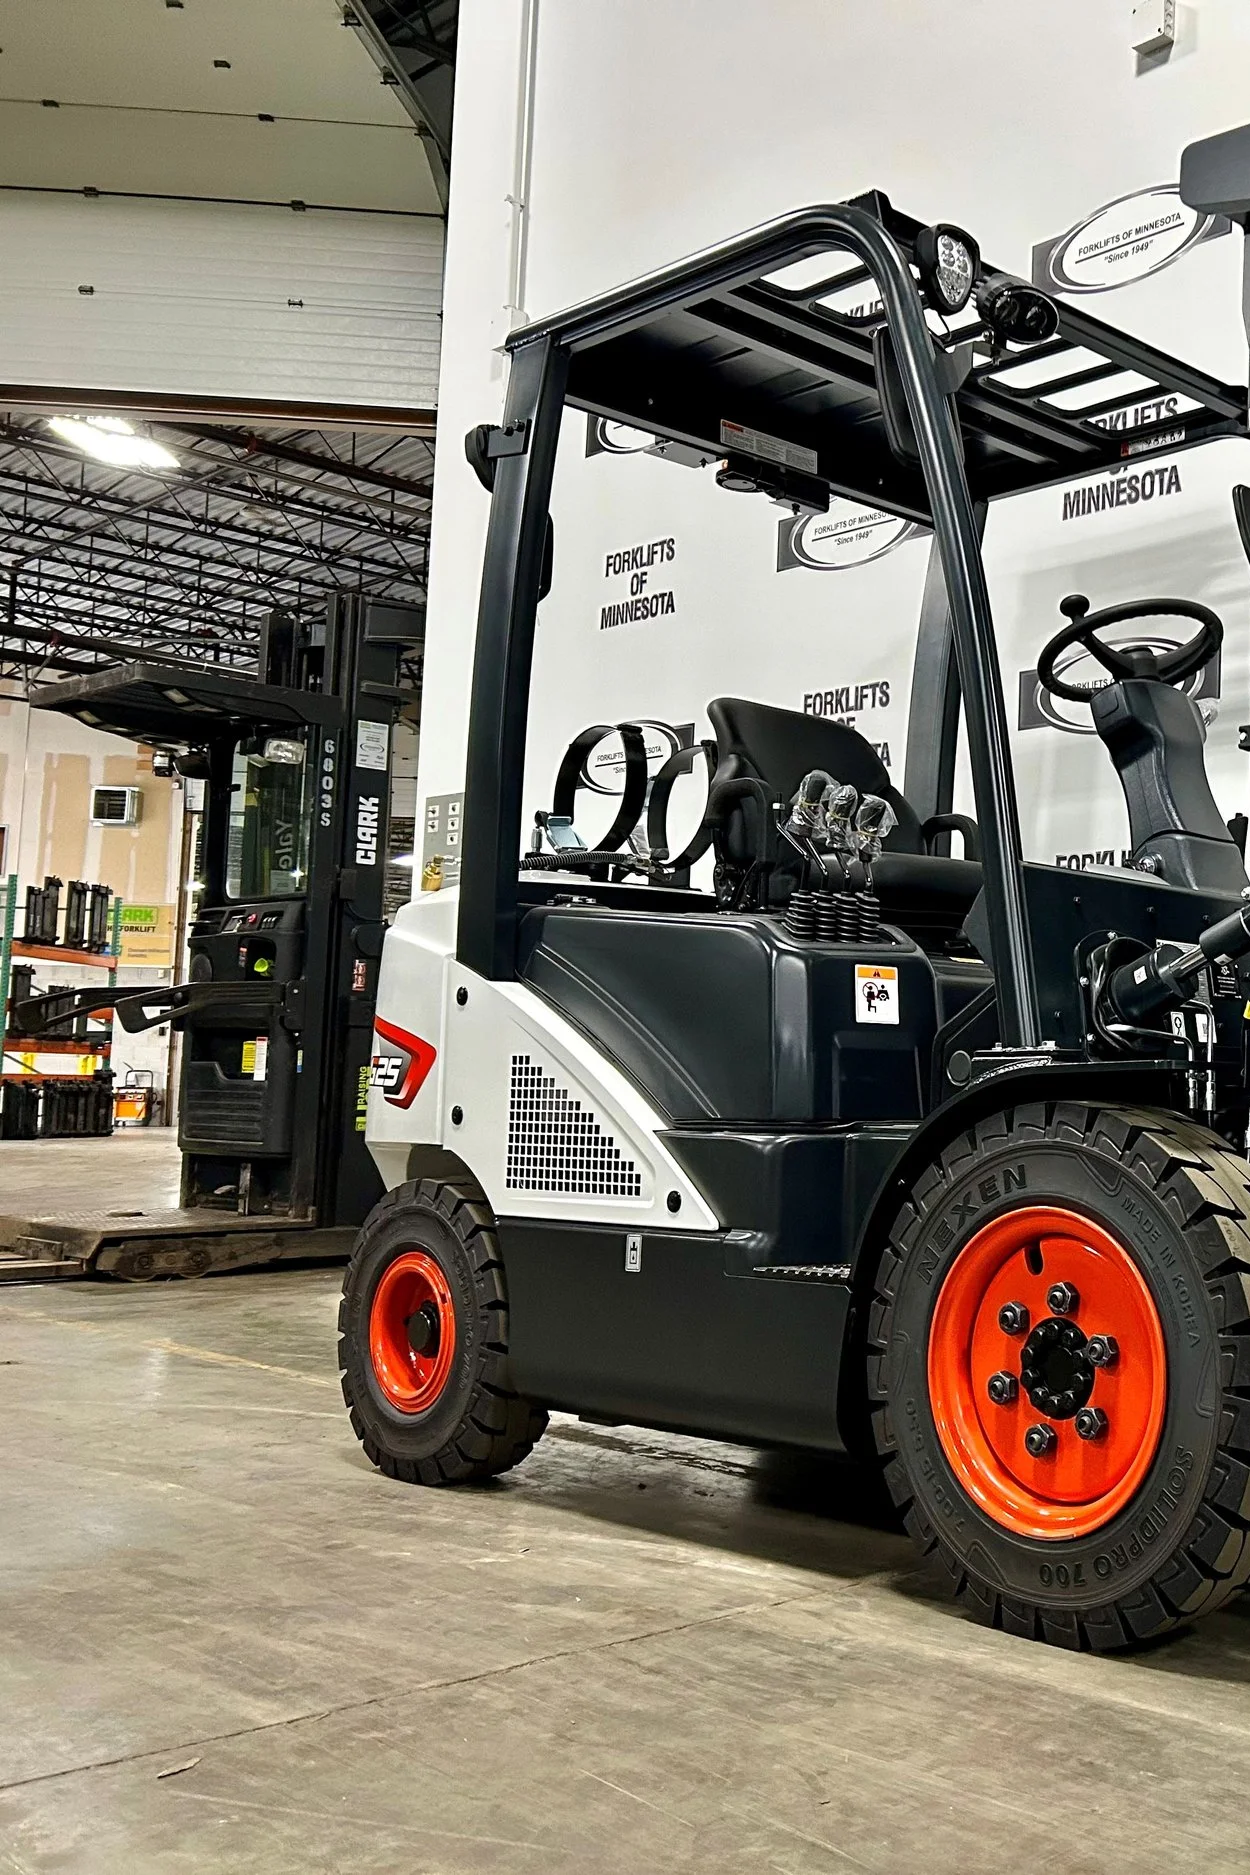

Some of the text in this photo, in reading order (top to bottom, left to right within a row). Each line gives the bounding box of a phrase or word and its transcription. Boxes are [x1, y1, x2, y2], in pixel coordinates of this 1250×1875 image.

[1078, 212, 1181, 257] FORKLIFTS OF MINNESOTA
[1063, 464, 1182, 521] MINNESOTA
[814, 511, 890, 536] FORKLIFTS OF MINNESO
[605, 538, 675, 577] FORKLIFTS
[630, 571, 648, 596] OF
[600, 591, 676, 630] MINNESOTA
[803, 681, 890, 717] FORKLIFTS
[355, 796, 380, 866] CLARK
[120, 925, 156, 933] FORKLIFT
[123, 908, 154, 922] ARK
[917, 1163, 1027, 1286] NEXEN
[1120, 1196, 1162, 1244] MADE
[1159, 1246, 1177, 1269] IN
[1171, 1274, 1200, 1348] KOREA
[1039, 1445, 1194, 1588] SOLIDPRO 700
